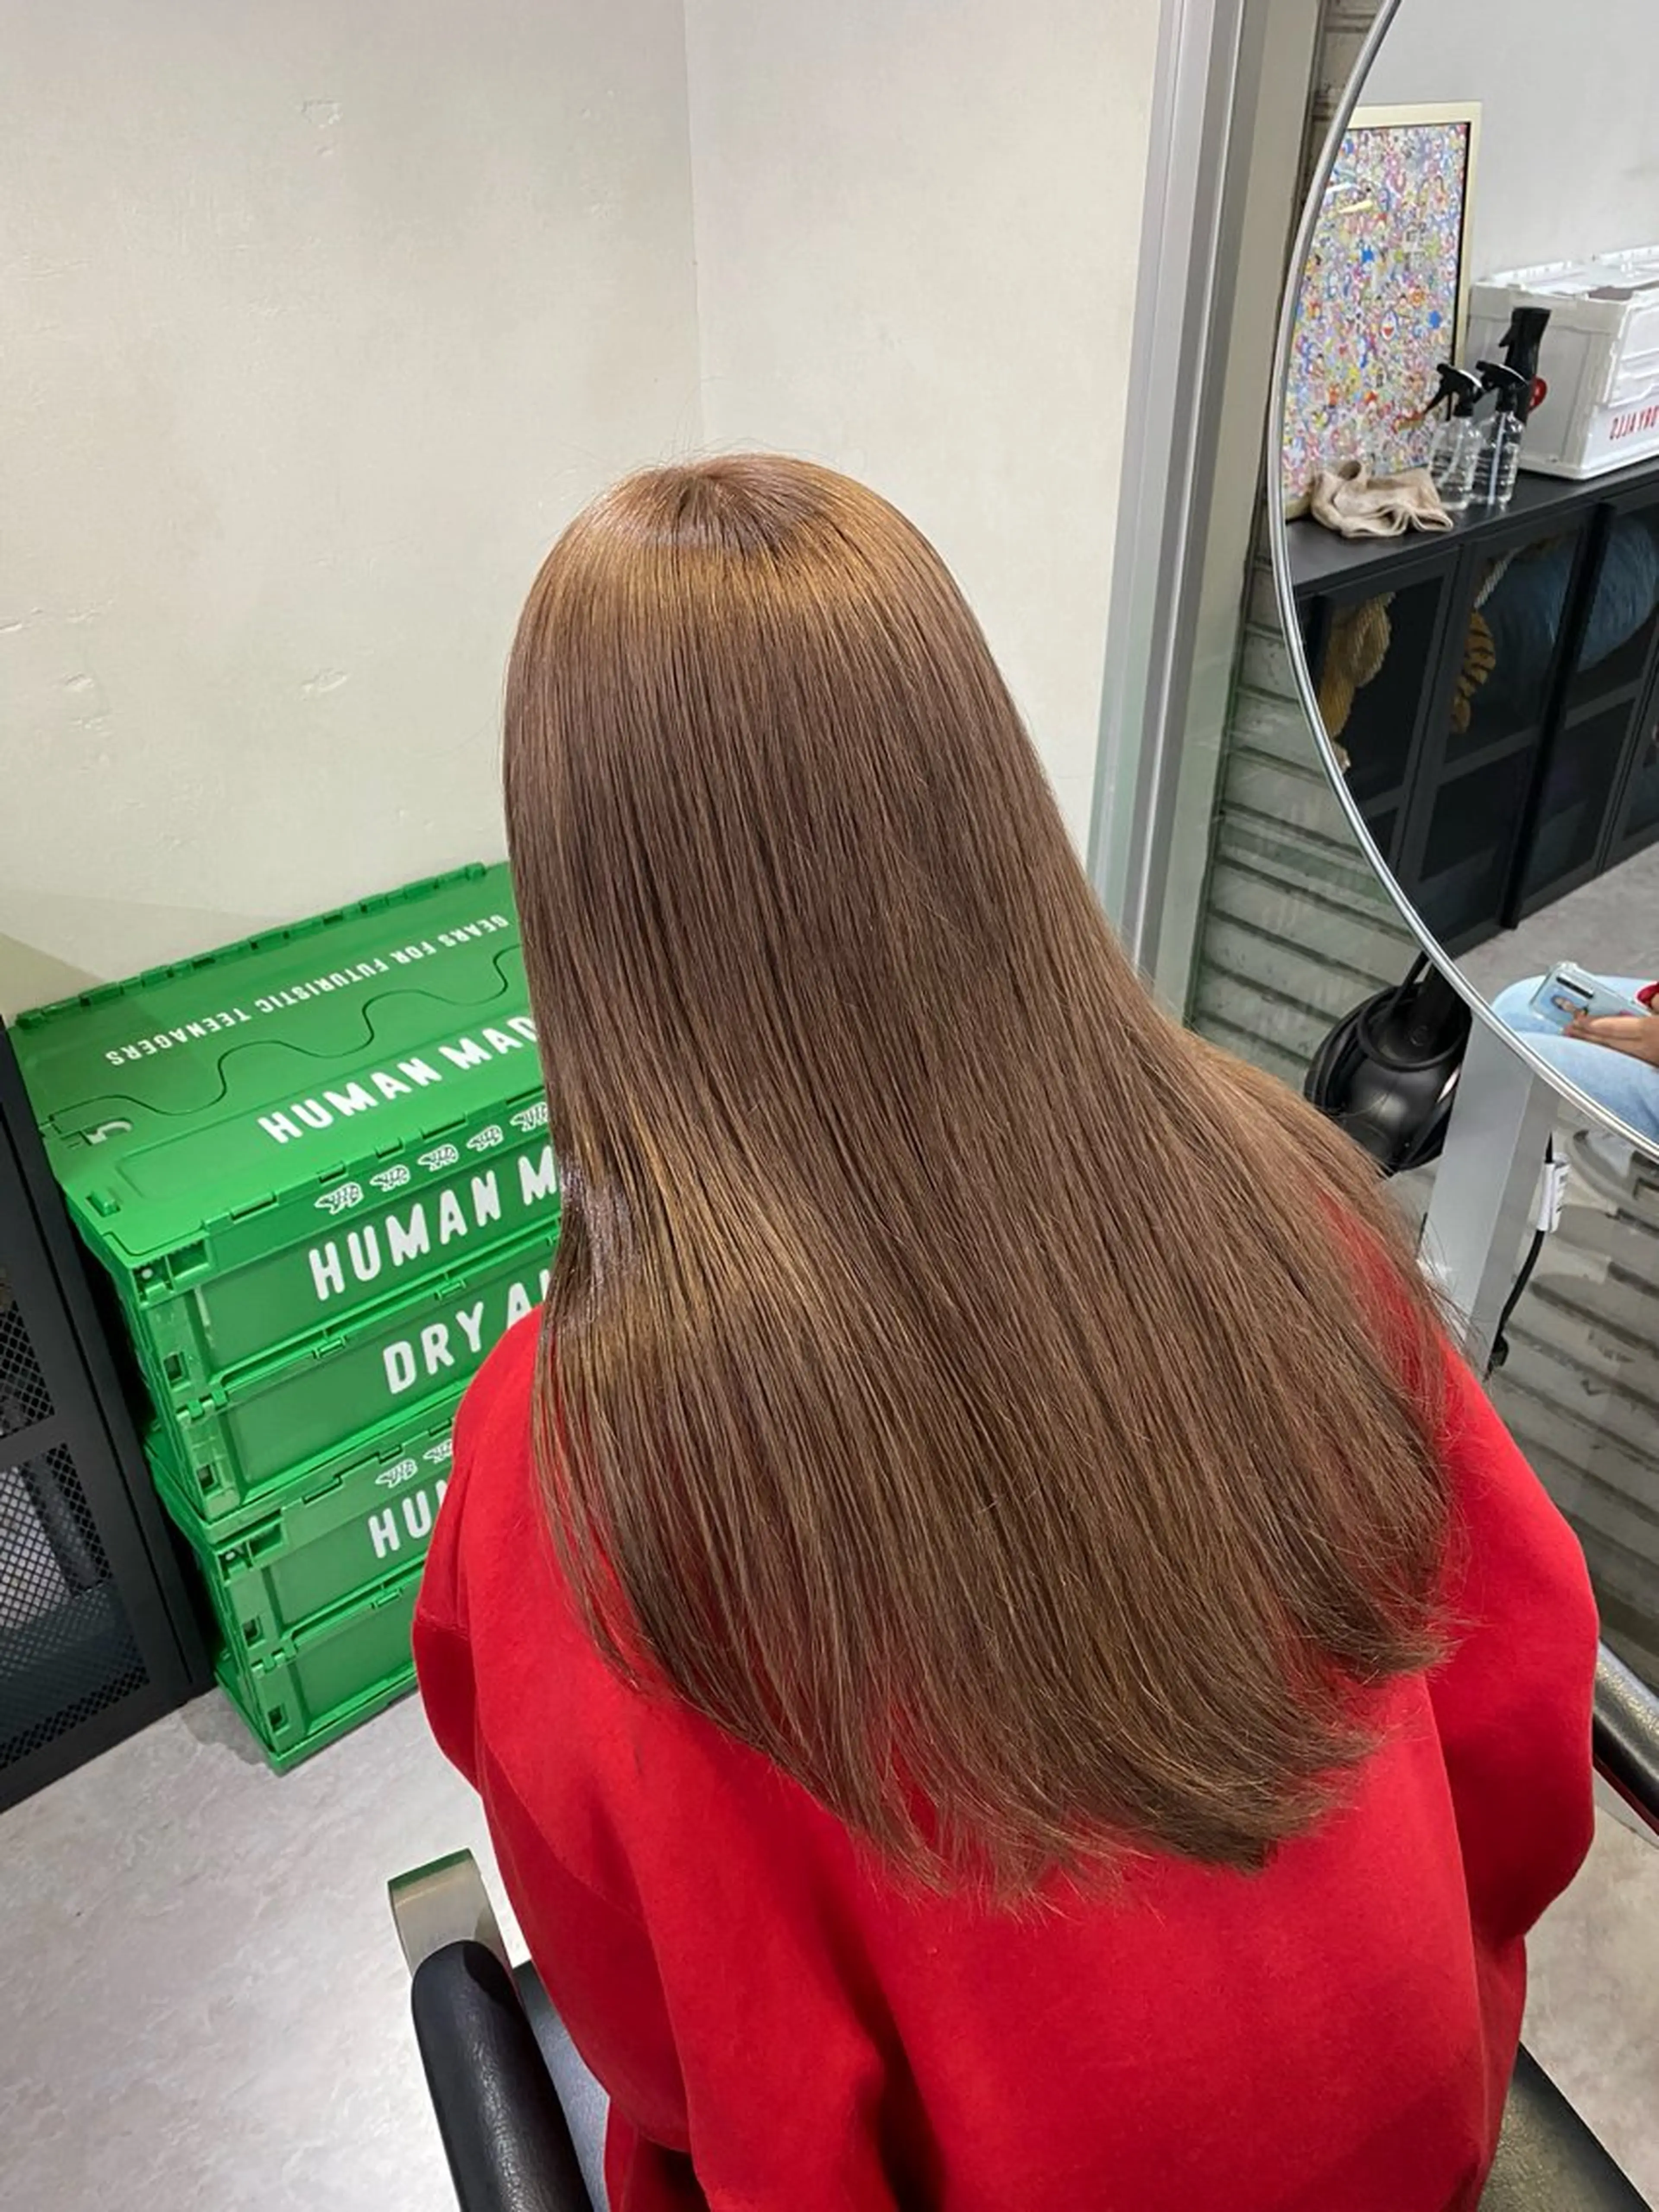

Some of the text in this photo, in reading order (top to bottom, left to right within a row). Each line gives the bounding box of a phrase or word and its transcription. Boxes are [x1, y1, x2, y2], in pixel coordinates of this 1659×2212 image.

[105, 915, 509, 1065] GEARS FOR FUTURISTIC TEENAGERS
[257, 1058, 443, 1144] HUMAN
[308, 1169, 501, 1301] HUMAN
[383, 1301, 484, 1394] DRY
[368, 1479, 448, 1558] HU
